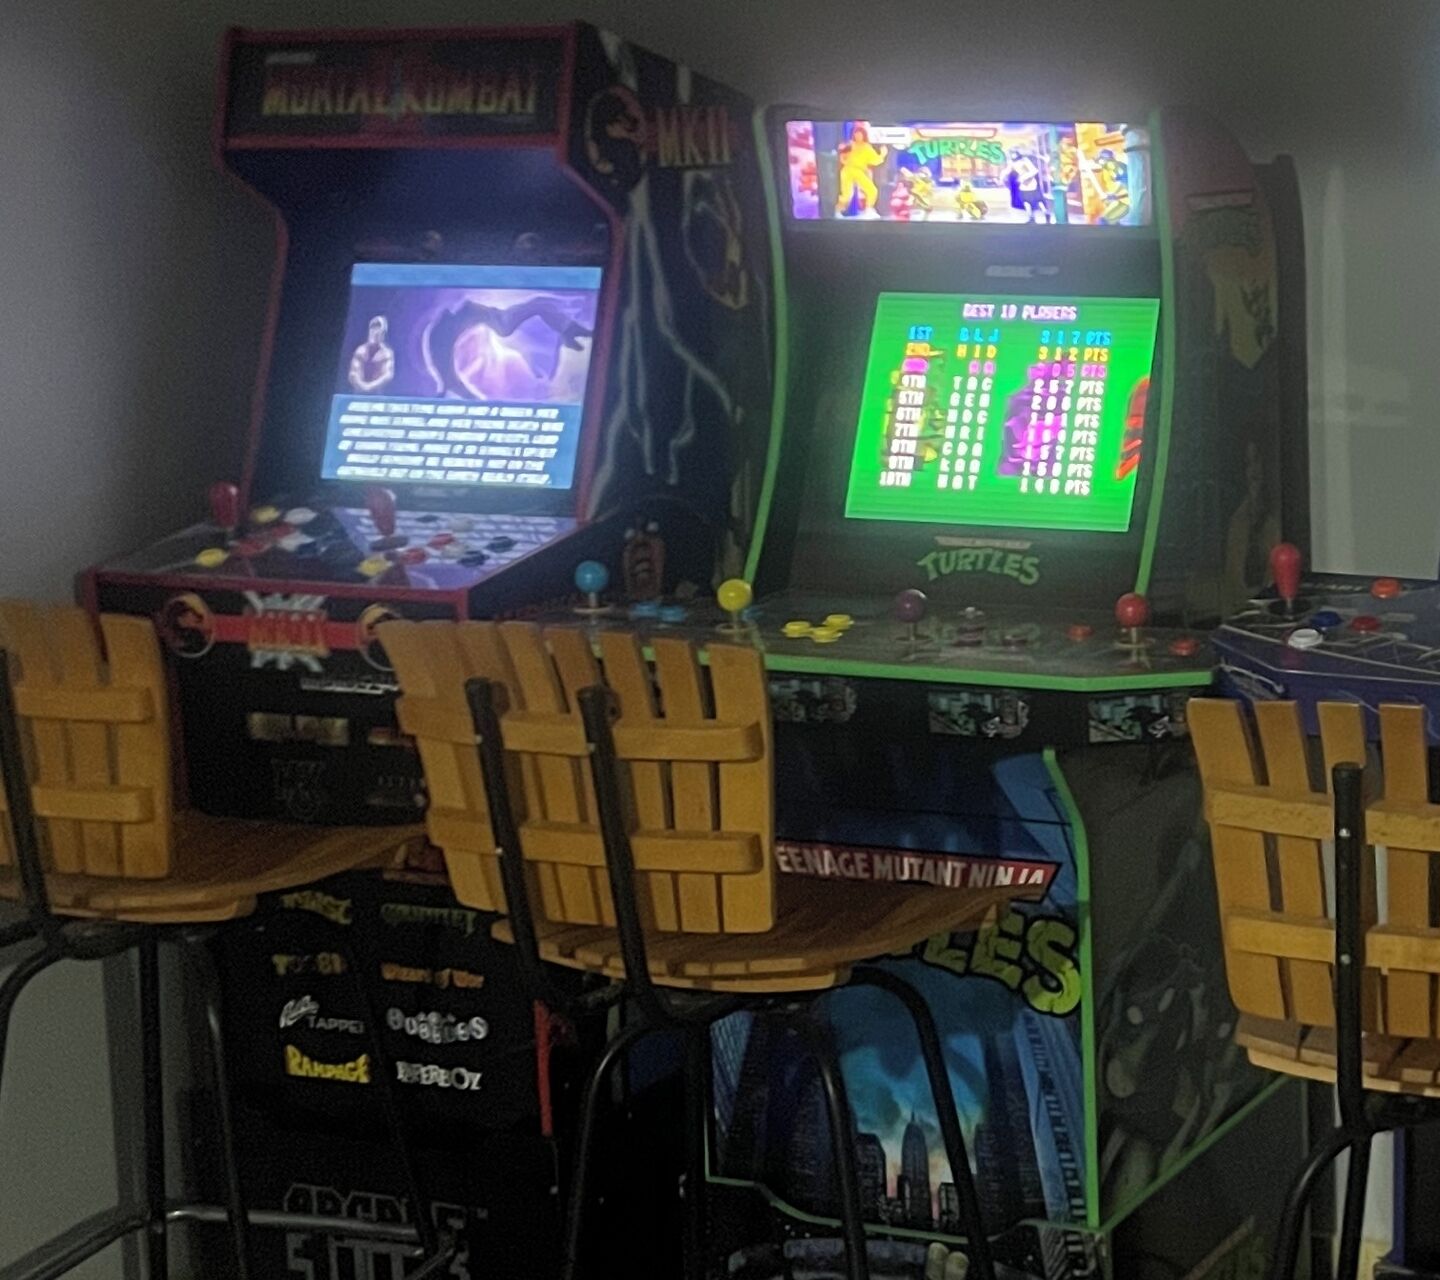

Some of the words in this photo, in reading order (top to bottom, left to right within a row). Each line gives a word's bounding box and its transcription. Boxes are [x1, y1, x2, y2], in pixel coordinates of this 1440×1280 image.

[910, 137, 1007, 165] TURTLES
[963, 304, 995, 318] BEST
[1001, 304, 1017, 318] 10
[1022, 305, 1077, 320] PLAYERS
[1086, 331, 1111, 346] PTS
[1083, 347, 1109, 362] PTS
[1078, 380, 1104, 395] PTS
[1076, 397, 1102, 411] PTS
[1074, 413, 1100, 428] PTS
[1071, 429, 1097, 445] PTS
[1069, 446, 1095, 461] PTS
[1066, 463, 1092, 478] PTS
[1064, 479, 1090, 495] PTS
[916, 547, 1041, 587] TURTLES
[776, 845, 871, 879] EENAGE
[873, 855, 967, 888] MUTANT
